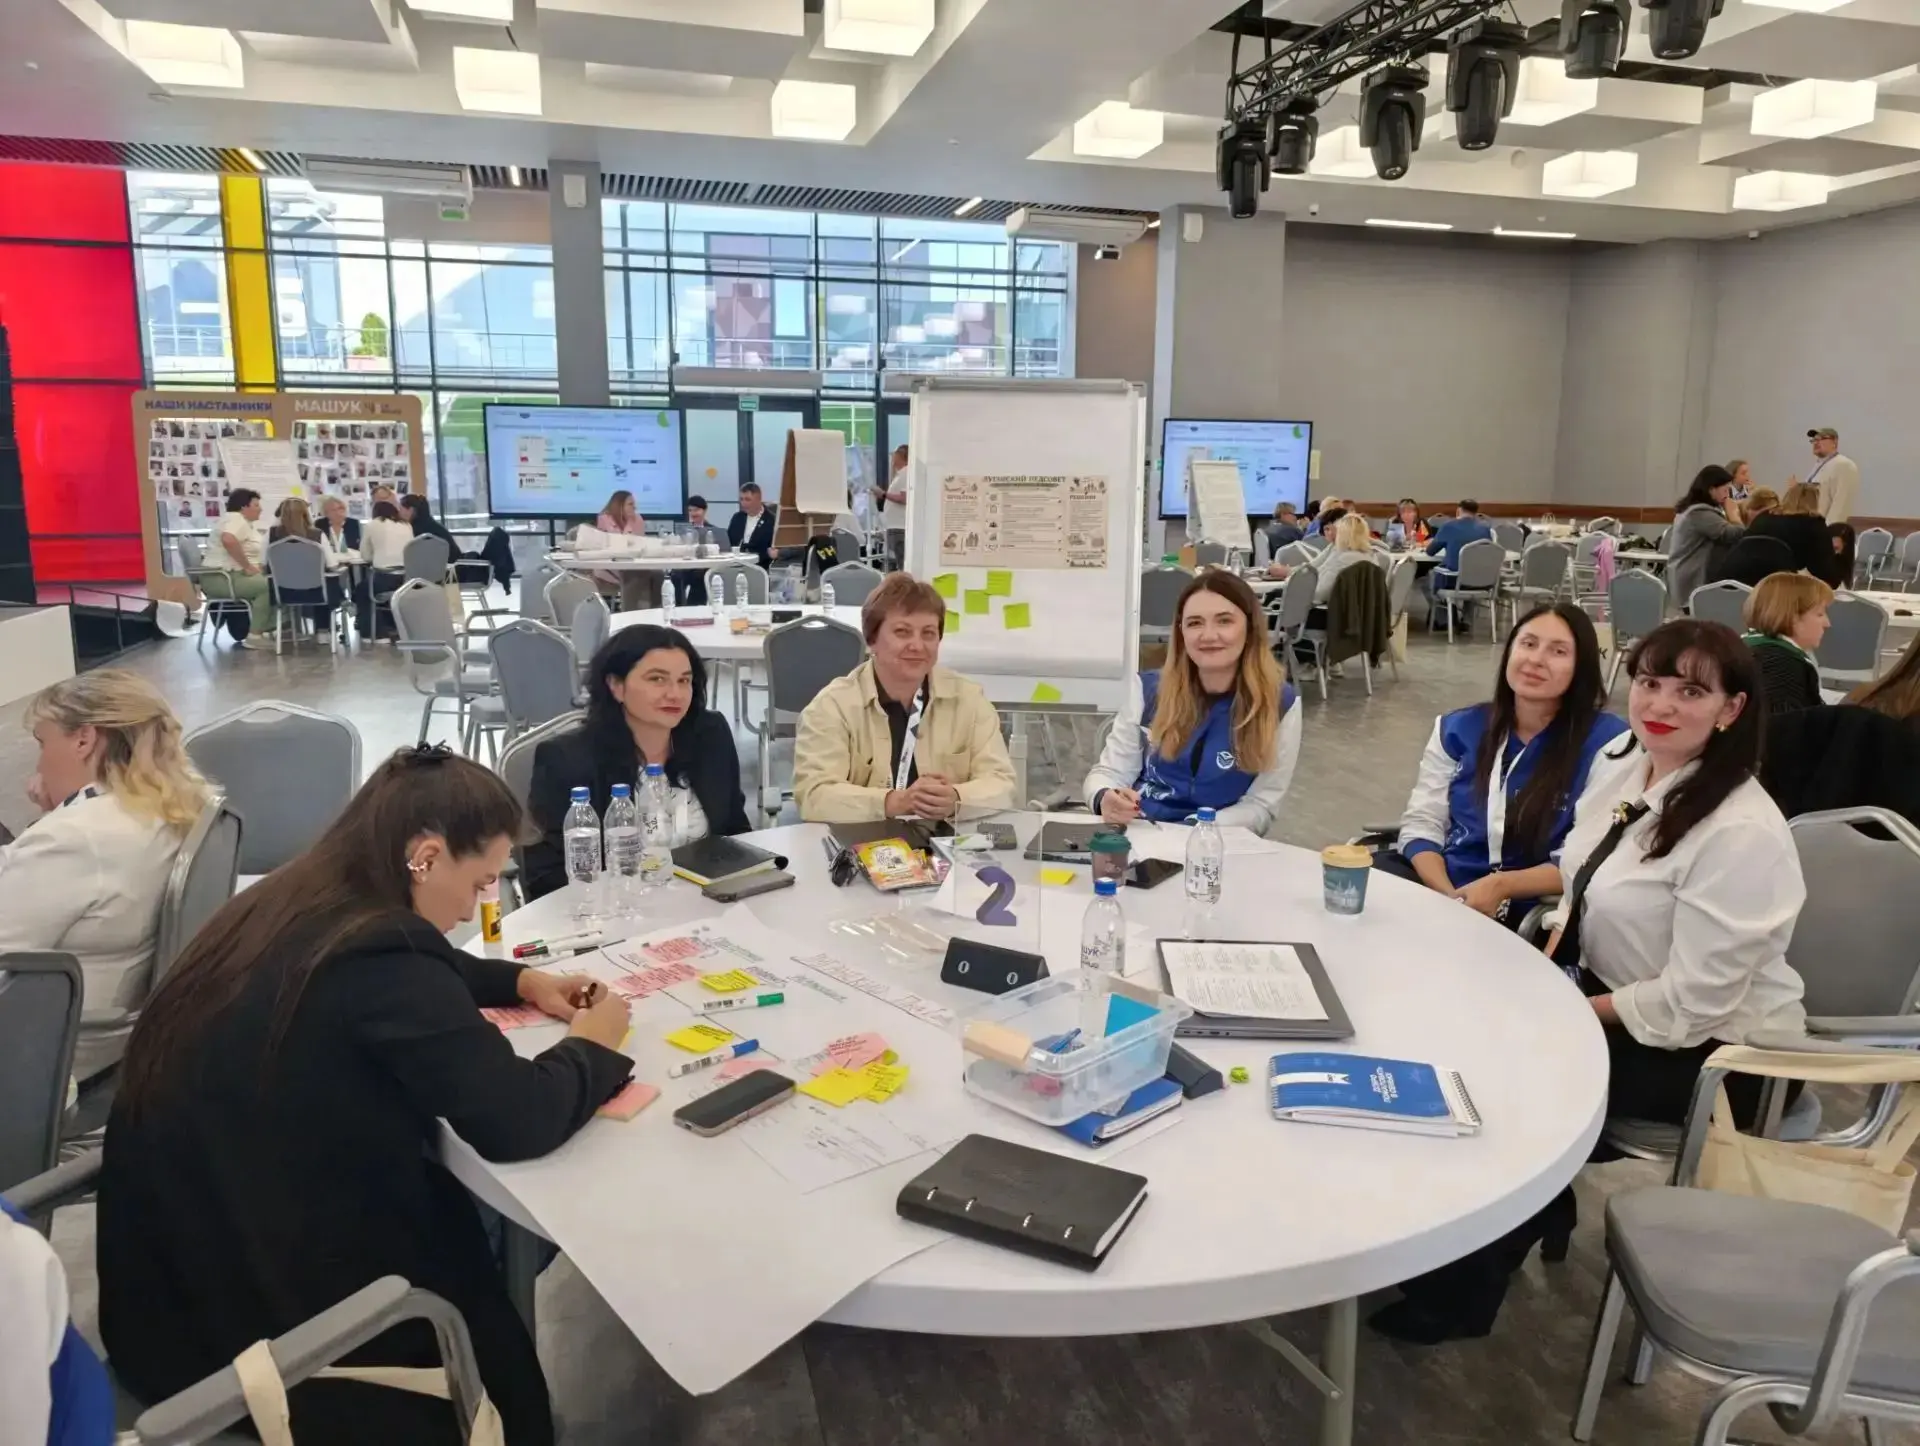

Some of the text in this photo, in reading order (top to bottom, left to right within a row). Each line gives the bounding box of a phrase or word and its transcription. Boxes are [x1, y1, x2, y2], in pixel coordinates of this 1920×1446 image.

[145, 400, 272, 411] НАШИ НАСТАВНИКИ
[294, 399, 362, 414] МАШУК
[975, 866, 1016, 925] 2
